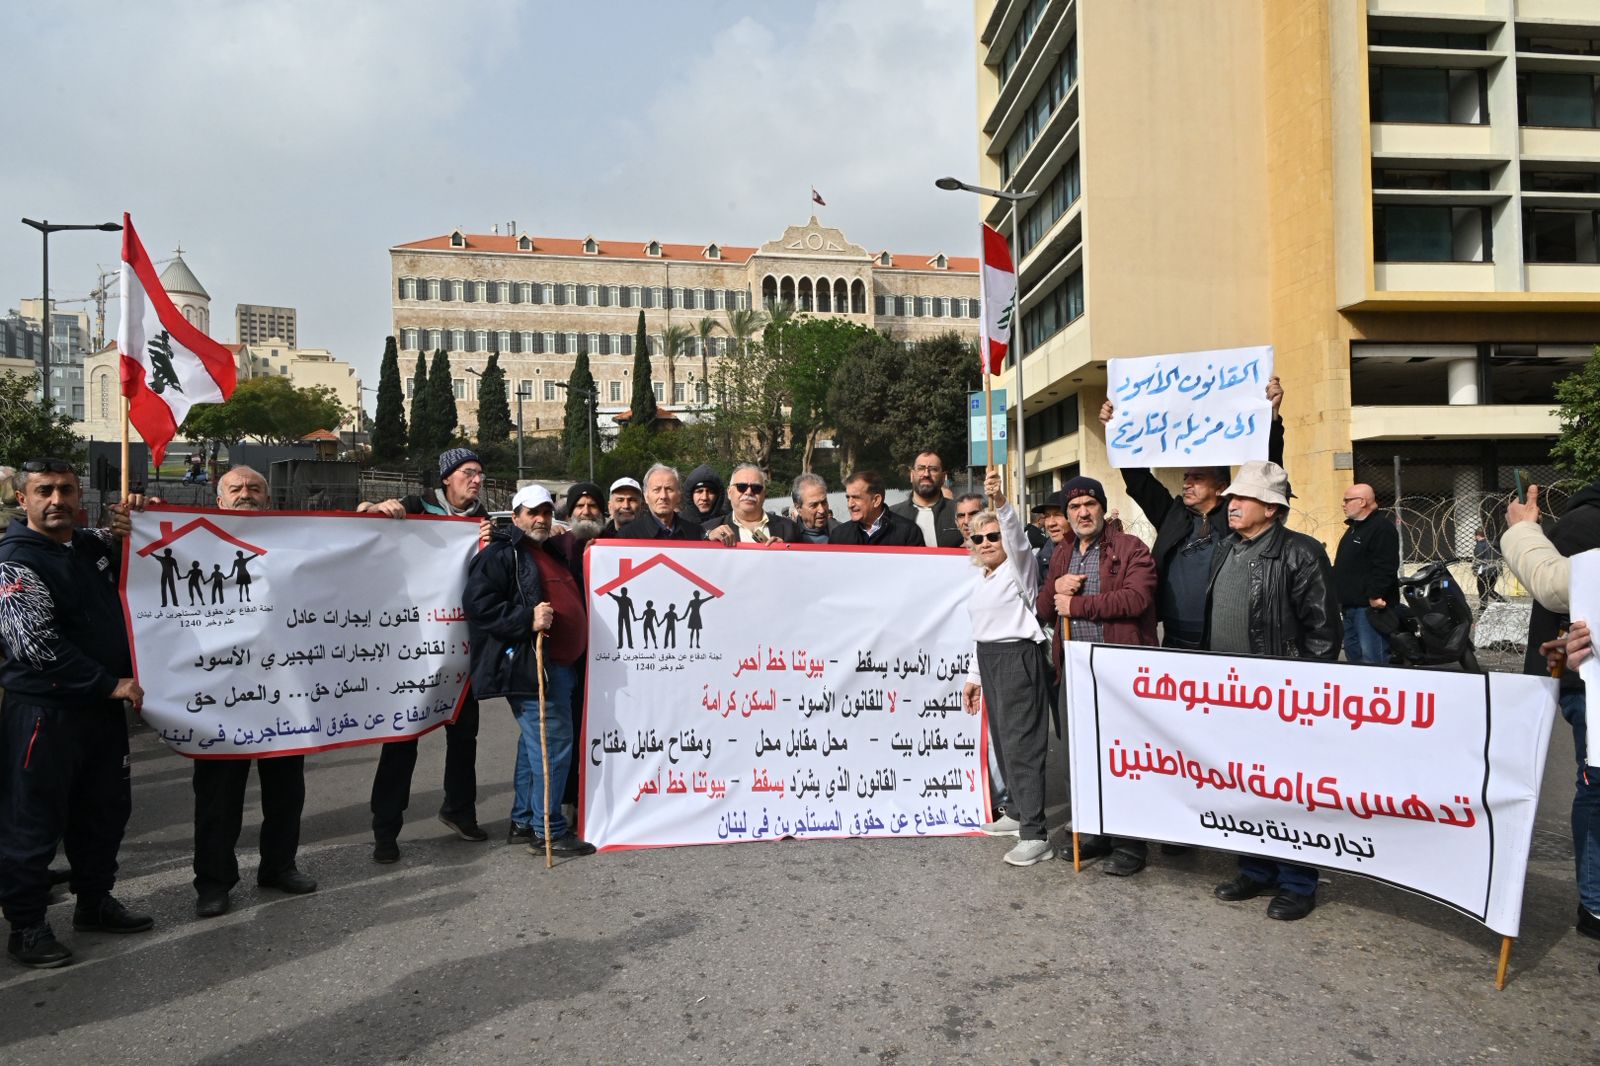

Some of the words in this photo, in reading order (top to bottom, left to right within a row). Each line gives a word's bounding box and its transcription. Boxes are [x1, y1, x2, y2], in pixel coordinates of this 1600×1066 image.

[1177, 358, 1259, 401] القانون
[1111, 410, 1169, 455] التاريخ
[1172, 412, 1225, 454] مزبلة
[180, 619, 202, 628] 1240
[204, 608, 224, 618] حقوق
[226, 608, 237, 616] عن
[286, 608, 317, 628] عادل
[323, 609, 371, 628] إيجارات
[379, 606, 420, 627] قانون
[194, 645, 251, 672] الأسود
[261, 644, 326, 670] التهجيري
[331, 642, 390, 663] الإيجارات
[398, 640, 445, 660] لقانون
[658, 652, 676, 662] حقوق
[677, 653, 687, 661] عن
[732, 643, 761, 678] أحمر
[766, 647, 787, 672] خط
[792, 649, 825, 679] بيوتنا
[855, 649, 888, 679] يسقط
[893, 648, 931, 679] الأسود
[636, 663, 655, 671] 1240
[334, 676, 368, 698] السكن
[389, 672, 442, 694] للتهجير
[1132, 666, 1273, 714] مشبوهة
[186, 691, 217, 713] حق
[433, 697, 456, 714] لجنة
[702, 683, 737, 718] كرامة
[741, 687, 776, 718] السكن
[798, 684, 836, 718] الأسود
[841, 688, 883, 718] للقانون
[887, 689, 897, 713] لا
[918, 689, 963, 719] للتهجير
[1278, 678, 1406, 731] لقوانين
[1411, 691, 1435, 729] لا
[233, 717, 322, 745] المستأجرين
[326, 713, 358, 737] حقوق
[364, 713, 385, 730] عن
[392, 705, 430, 731] الدفاع
[159, 727, 194, 746] لبنا
[198, 724, 226, 749] في
[591, 728, 627, 767] مفتاح
[632, 728, 664, 760] مقابل
[668, 728, 712, 764] ومفتاح
[755, 727, 781, 758] محل
[785, 728, 817, 758] مقابل
[822, 728, 848, 757] محل
[891, 731, 913, 757] بيت
[917, 728, 949, 757] مقابل
[953, 731, 975, 757] بيت
[965, 767, 976, 793] لا
[1108, 739, 1247, 793] المواطنين
[632, 766, 661, 802] أحمر
[666, 768, 688, 795] خط
[692, 768, 726, 800] بيوتنا
[751, 767, 785, 800] يسقط
[825, 765, 850, 803] الذي
[856, 767, 897, 799] القانون
[919, 767, 963, 799] للتهجير
[1247, 763, 1344, 812] كرامة
[717, 809, 747, 839] لبنان
[849, 808, 885, 836] حقوق
[890, 812, 909, 833] عن
[914, 805, 948, 835] الدفاع
[953, 803, 981, 831] لجنة
[1345, 791, 1476, 828] تدهس
[1199, 810, 1266, 844] بعلبك
[1265, 819, 1332, 851] مدينة
[1333, 832, 1376, 862] تجار
